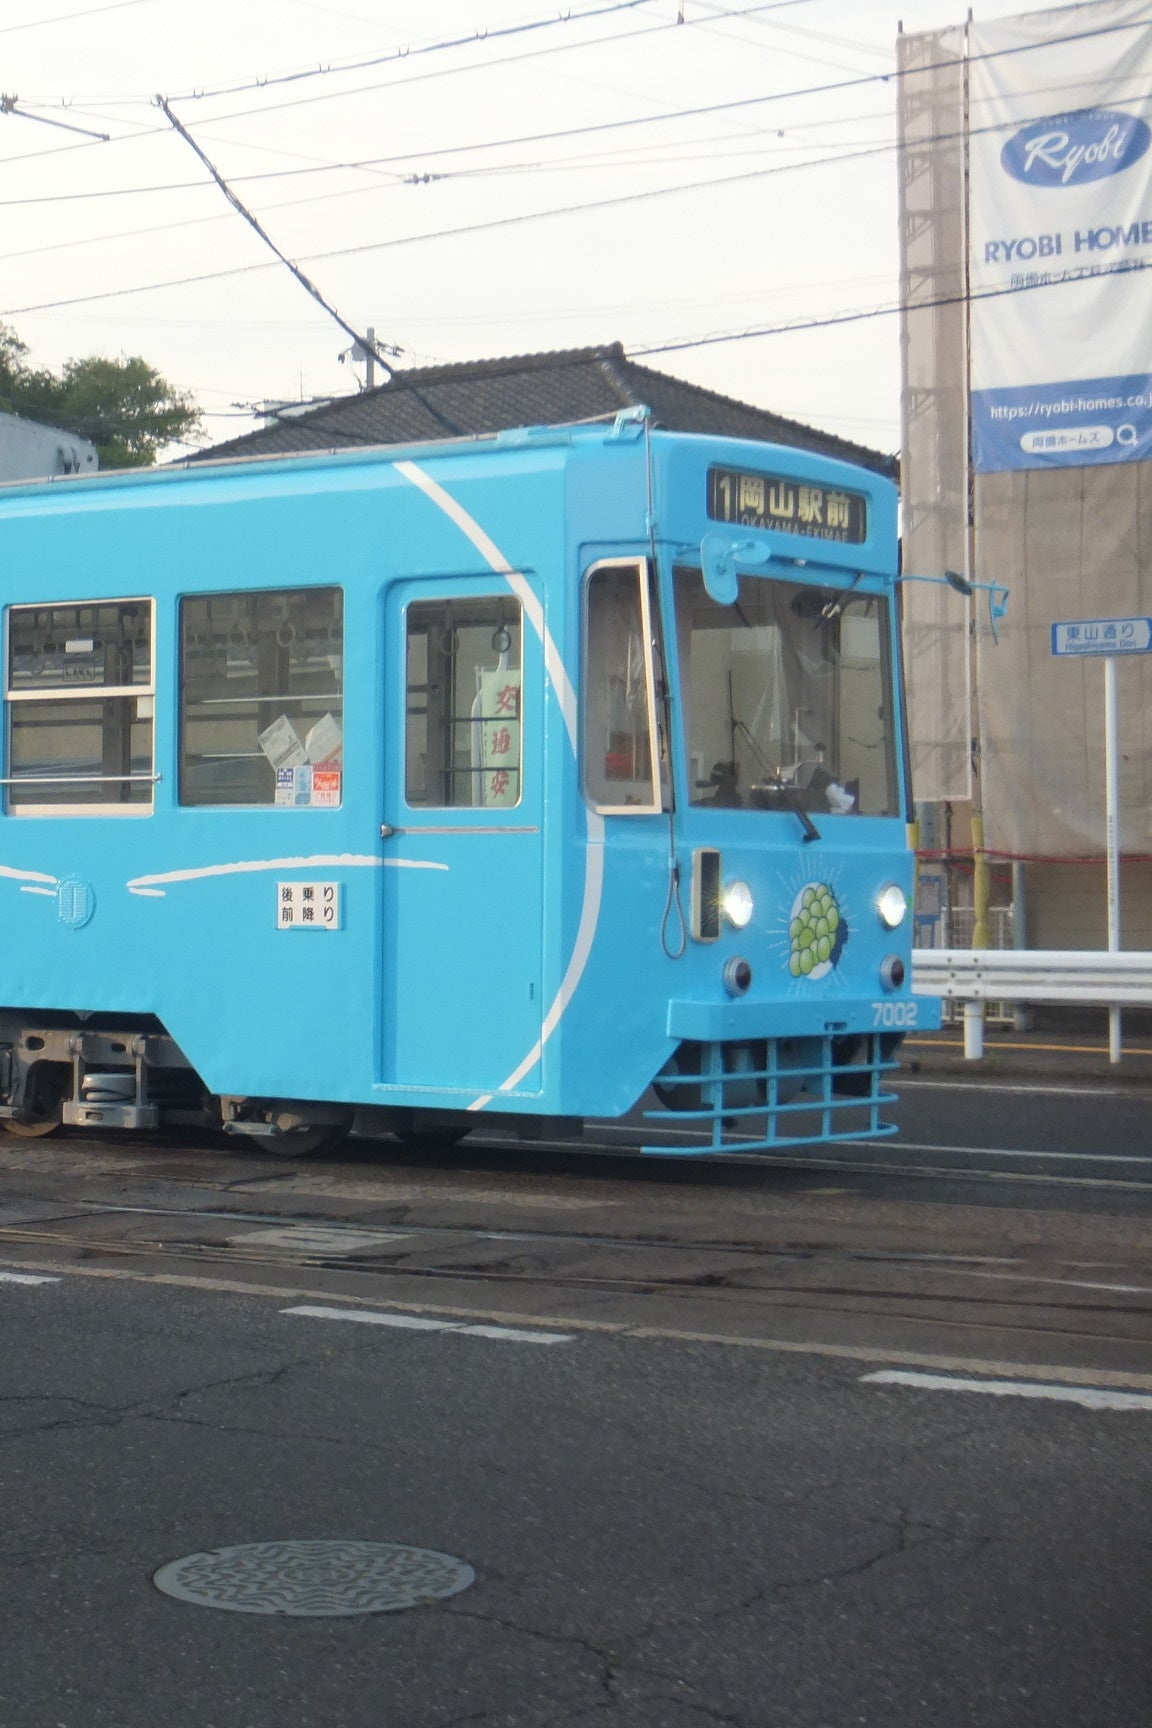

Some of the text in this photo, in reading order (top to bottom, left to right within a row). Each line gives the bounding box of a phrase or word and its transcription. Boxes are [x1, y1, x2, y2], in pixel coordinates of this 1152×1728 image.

[1025, 124, 1126, 184] Ryobi
[984, 233, 1062, 263] RYOBI
[720, 475, 849, 529] 1 岡山駅前
[281, 887, 335, 902] 後乗り
[281, 907, 335, 922] 前降り
[871, 1002, 918, 1026] 7002
